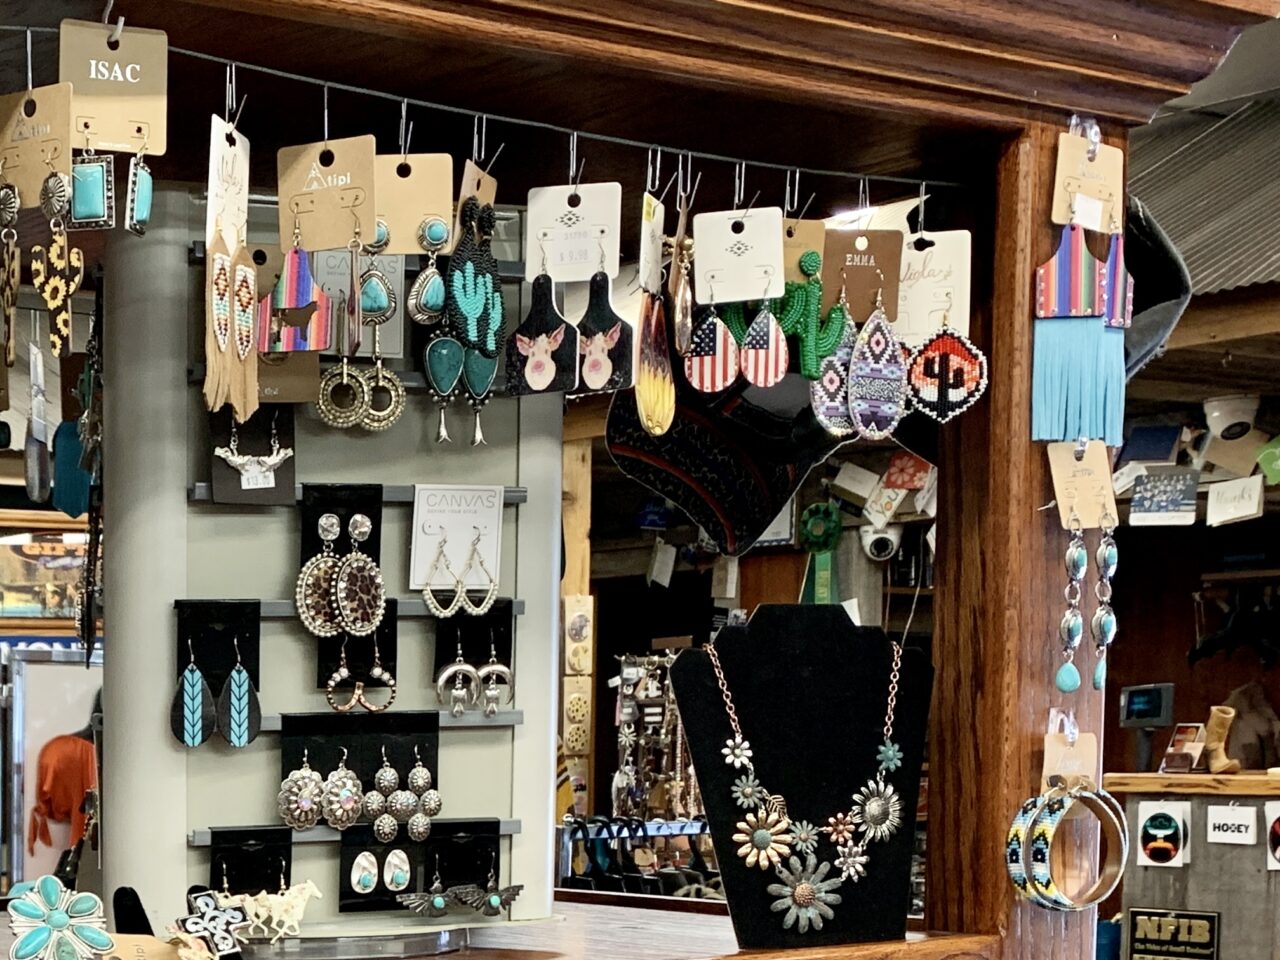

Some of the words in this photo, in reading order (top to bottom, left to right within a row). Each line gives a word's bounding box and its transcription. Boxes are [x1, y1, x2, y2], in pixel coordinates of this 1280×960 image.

[89, 59, 141, 83] ISAC
[327, 171, 351, 188] tipi
[845, 253, 876, 267] EMMA
[426, 493, 496, 508] CANVAS
[1212, 823, 1250, 834] HOOEY
[1135, 915, 1211, 943] NFIB
